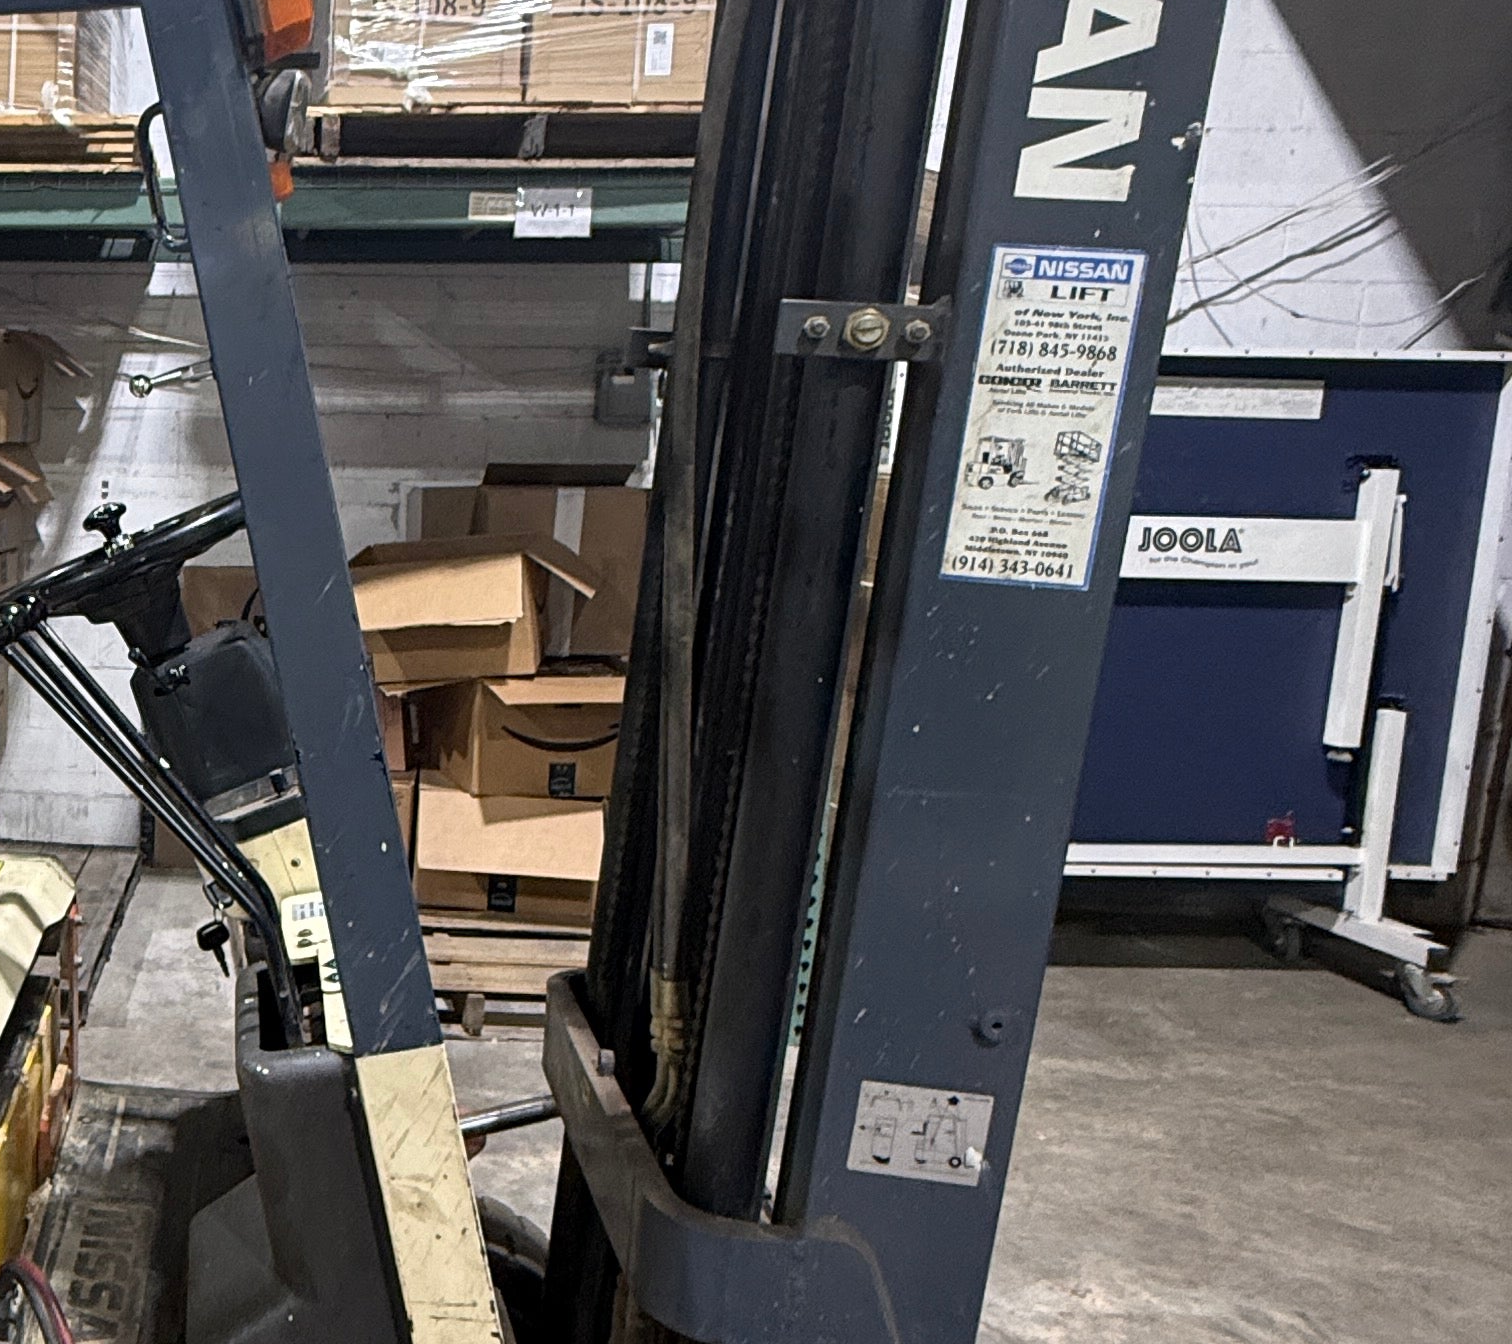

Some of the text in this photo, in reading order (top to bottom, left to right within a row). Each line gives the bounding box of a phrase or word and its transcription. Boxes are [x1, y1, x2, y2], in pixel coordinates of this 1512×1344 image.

[531, 203, 574, 217] W-1-1
[1038, 259, 1129, 281] NISSAN
[1050, 285, 1115, 302] LIFT
[1014, 308, 1029, 317] of
[1032, 309, 1064, 318] New
[1106, 313, 1130, 323] Inc.
[1073, 322, 1103, 331] Street
[990, 339, 1118, 361] (718) 845-9868
[996, 363, 1105, 378] Authorized Dealer
[1049, 378, 1118, 391] BARRETT
[988, 536, 1031, 547] Highland
[1138, 527, 1242, 553] JOOLA
[951, 555, 1074, 579] (914) 343-0641
